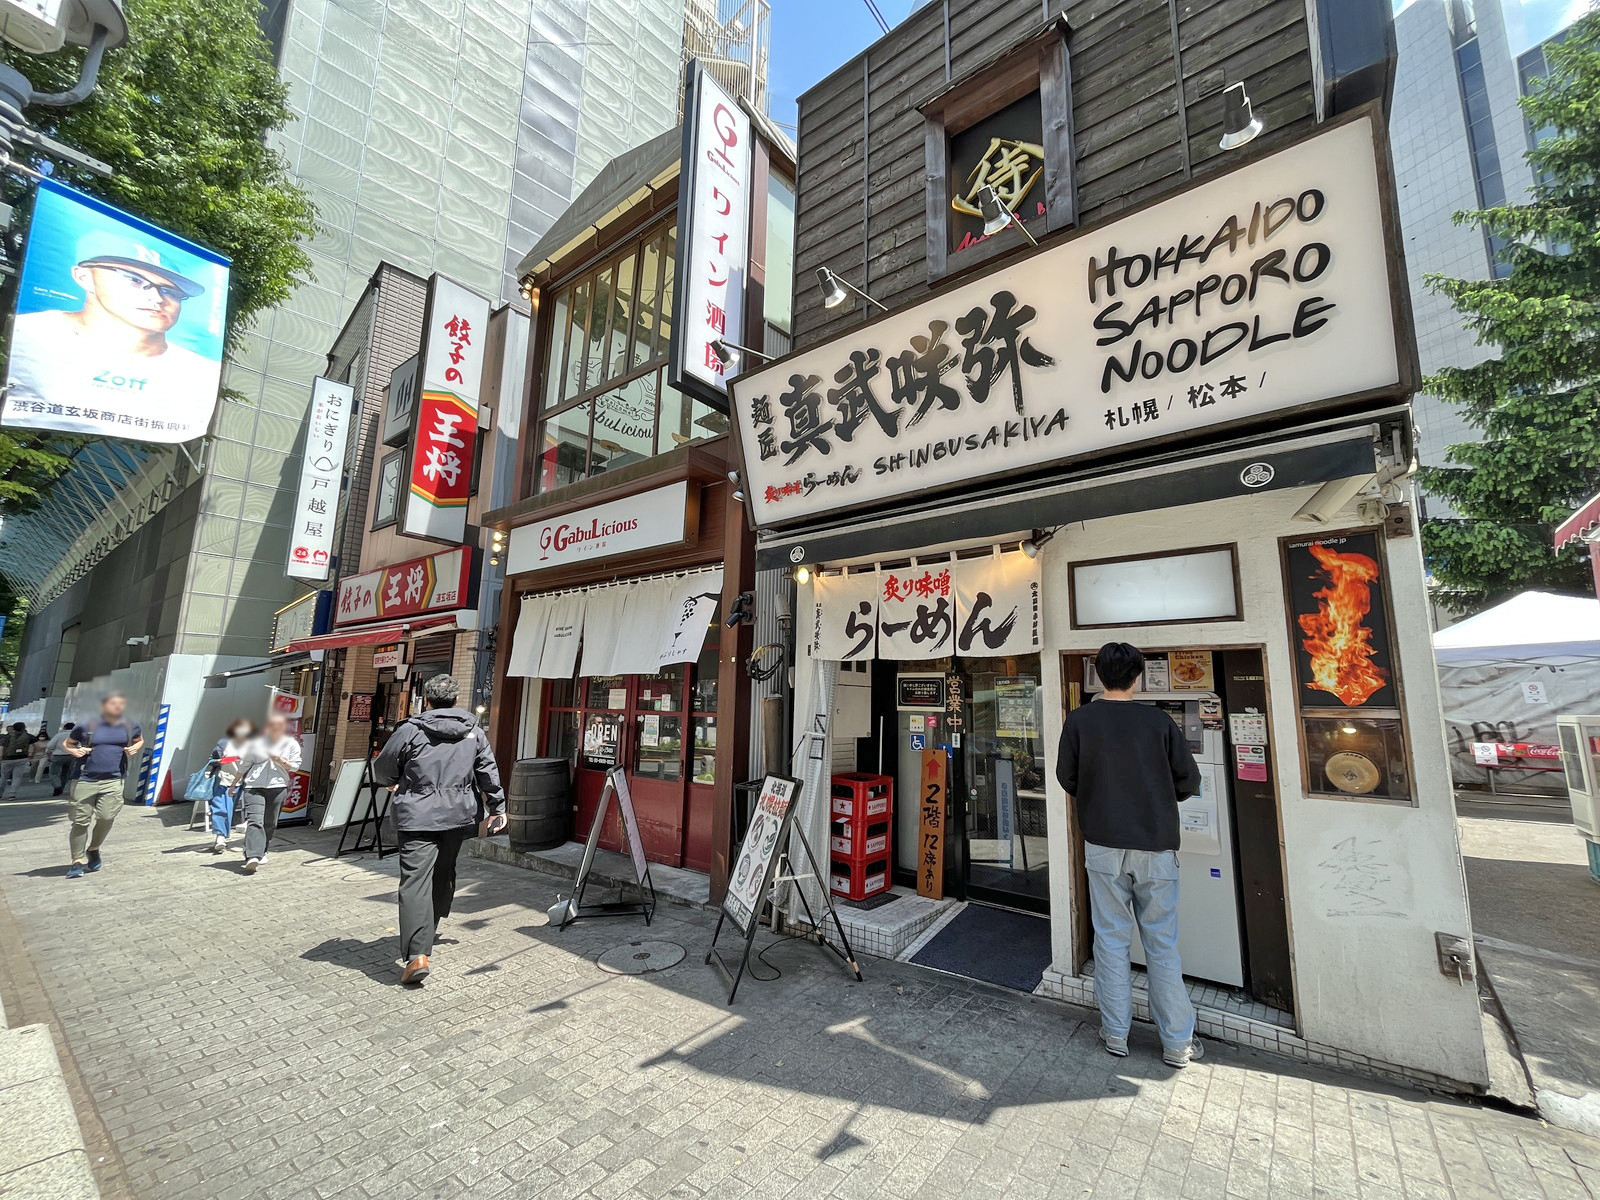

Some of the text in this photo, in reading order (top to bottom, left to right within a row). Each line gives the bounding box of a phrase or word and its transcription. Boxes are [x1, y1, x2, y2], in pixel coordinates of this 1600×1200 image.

[1088, 188, 1326, 304] HOKKAIDO
[1093, 242, 1331, 347] SAPPORO
[443, 313, 472, 385] 餃子の
[1100, 296, 1337, 394] NOODLE
[93, 370, 149, 391] Zoff
[778, 290, 1056, 467] 真武咲弥
[1104, 398, 1159, 430] 札幌
[1187, 375, 1247, 408] 松本
[323, 393, 343, 452] おにぎり
[422, 408, 466, 487] 王将
[873, 408, 1069, 475] SHINBUSAKIYA
[304, 476, 331, 537] 戸越屋
[553, 518, 638, 552] GabuLicious
[341, 563, 425, 614] 餃子の 王将
[883, 568, 952, 602] 炙り味噌
[842, 591, 1018, 660] らーめん
[591, 723, 618, 741] OPEN
[946, 675, 964, 732] 営業中
